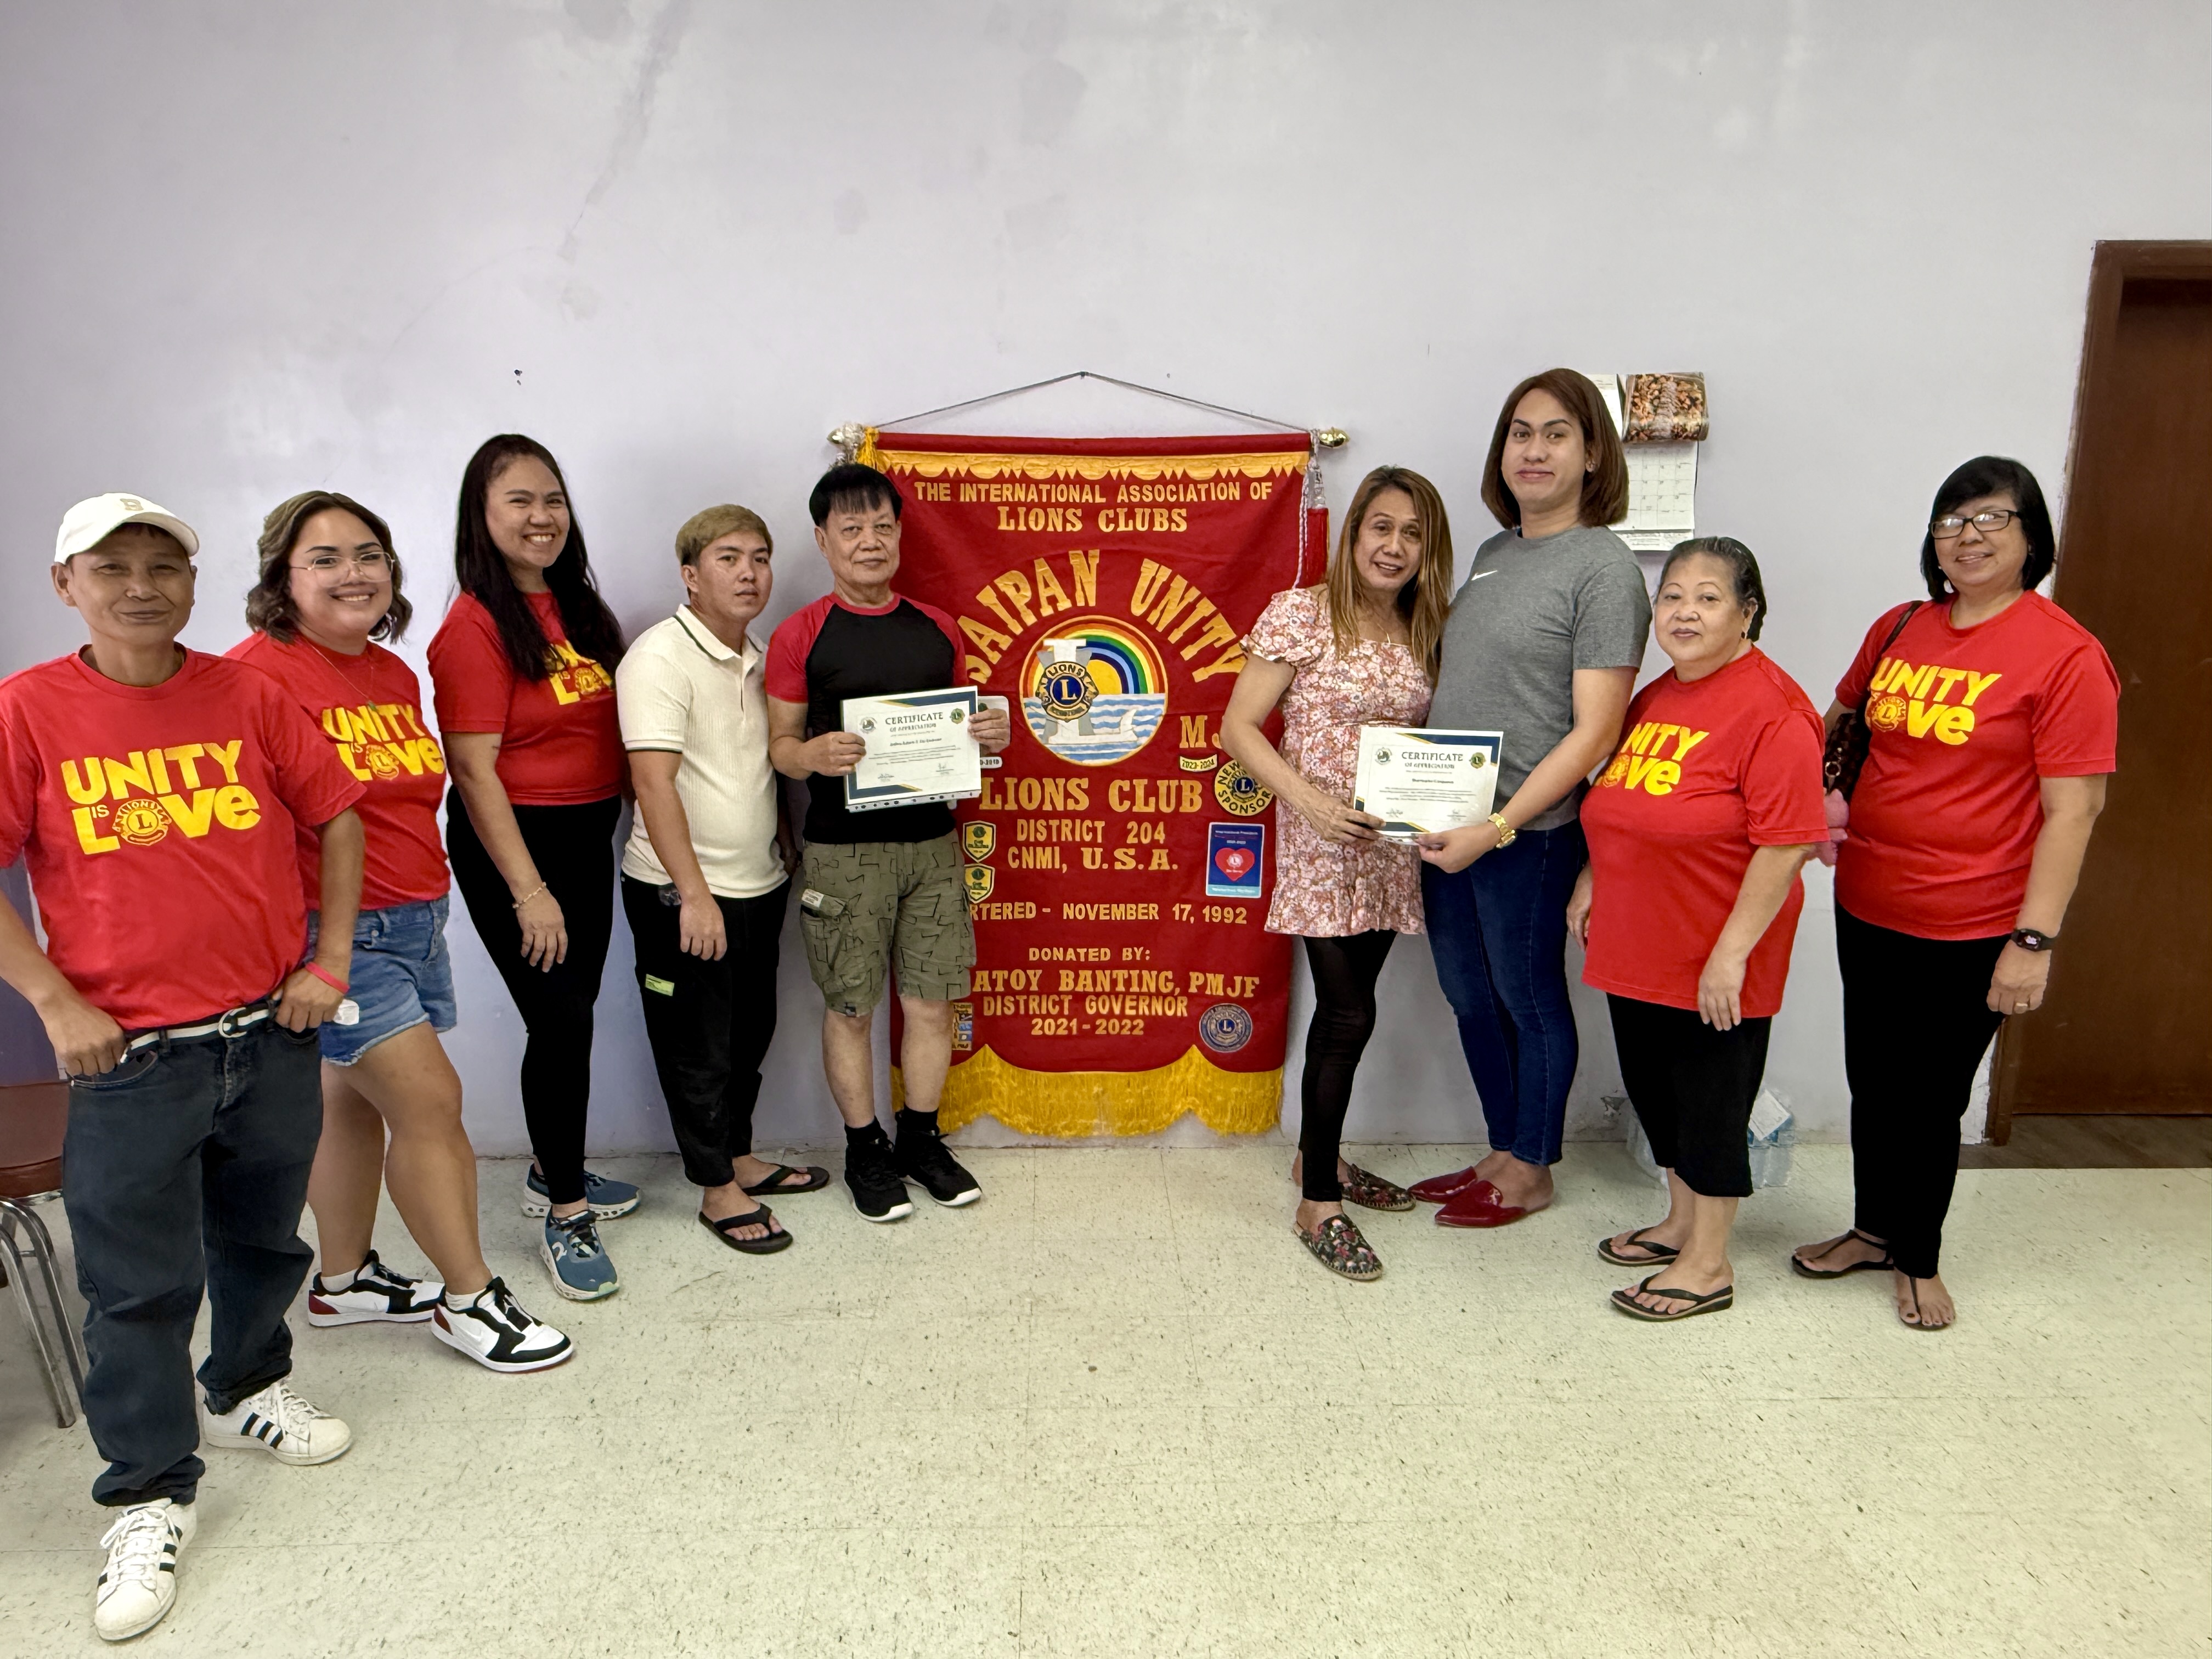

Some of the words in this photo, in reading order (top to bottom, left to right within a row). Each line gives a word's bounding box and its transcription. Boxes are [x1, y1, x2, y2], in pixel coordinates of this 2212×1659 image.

[914, 481, 951, 501] THE
[960, 482, 1106, 504] INTERNATIONAL
[1117, 481, 1240, 503] ASSOCIATION
[1250, 482, 1273, 500] OF
[998, 507, 1083, 532] LIONS
[1098, 508, 1188, 533] CLUBS
[1131, 558, 1248, 683] UNITY
[1060, 679, 1077, 700] L
[1870, 657, 2002, 706] UNITY
[322, 704, 425, 744] UNITY
[1620, 722, 1710, 761] NITY
[1401, 752, 1463, 761] CERTIFICATE
[61, 740, 242, 805] UNITY
[979, 777, 1090, 811] LIONS
[1108, 780, 1203, 813] CLUB
[1218, 790, 1271, 814] SPONSOR
[92, 804, 109, 819] IS
[1017, 819, 1105, 843] DISTRICT
[1127, 821, 1166, 844] 204
[1007, 846, 1068, 873] CNMI,
[1080, 848, 1179, 871] U.S.A.
[969, 901, 1036, 921] RTERED
[1063, 904, 1159, 921] NOVEMBER
[1172, 904, 1195, 924] 17,
[1203, 905, 1248, 924] 1992
[1029, 947, 1111, 962] DONATED
[1122, 946, 1151, 961] BY:
[1059, 970, 1181, 997] BANTING,
[1188, 972, 1260, 998] PMJF
[983, 995, 1073, 1016] DISTRICT
[1085, 996, 1188, 1017] GOVERNOR
